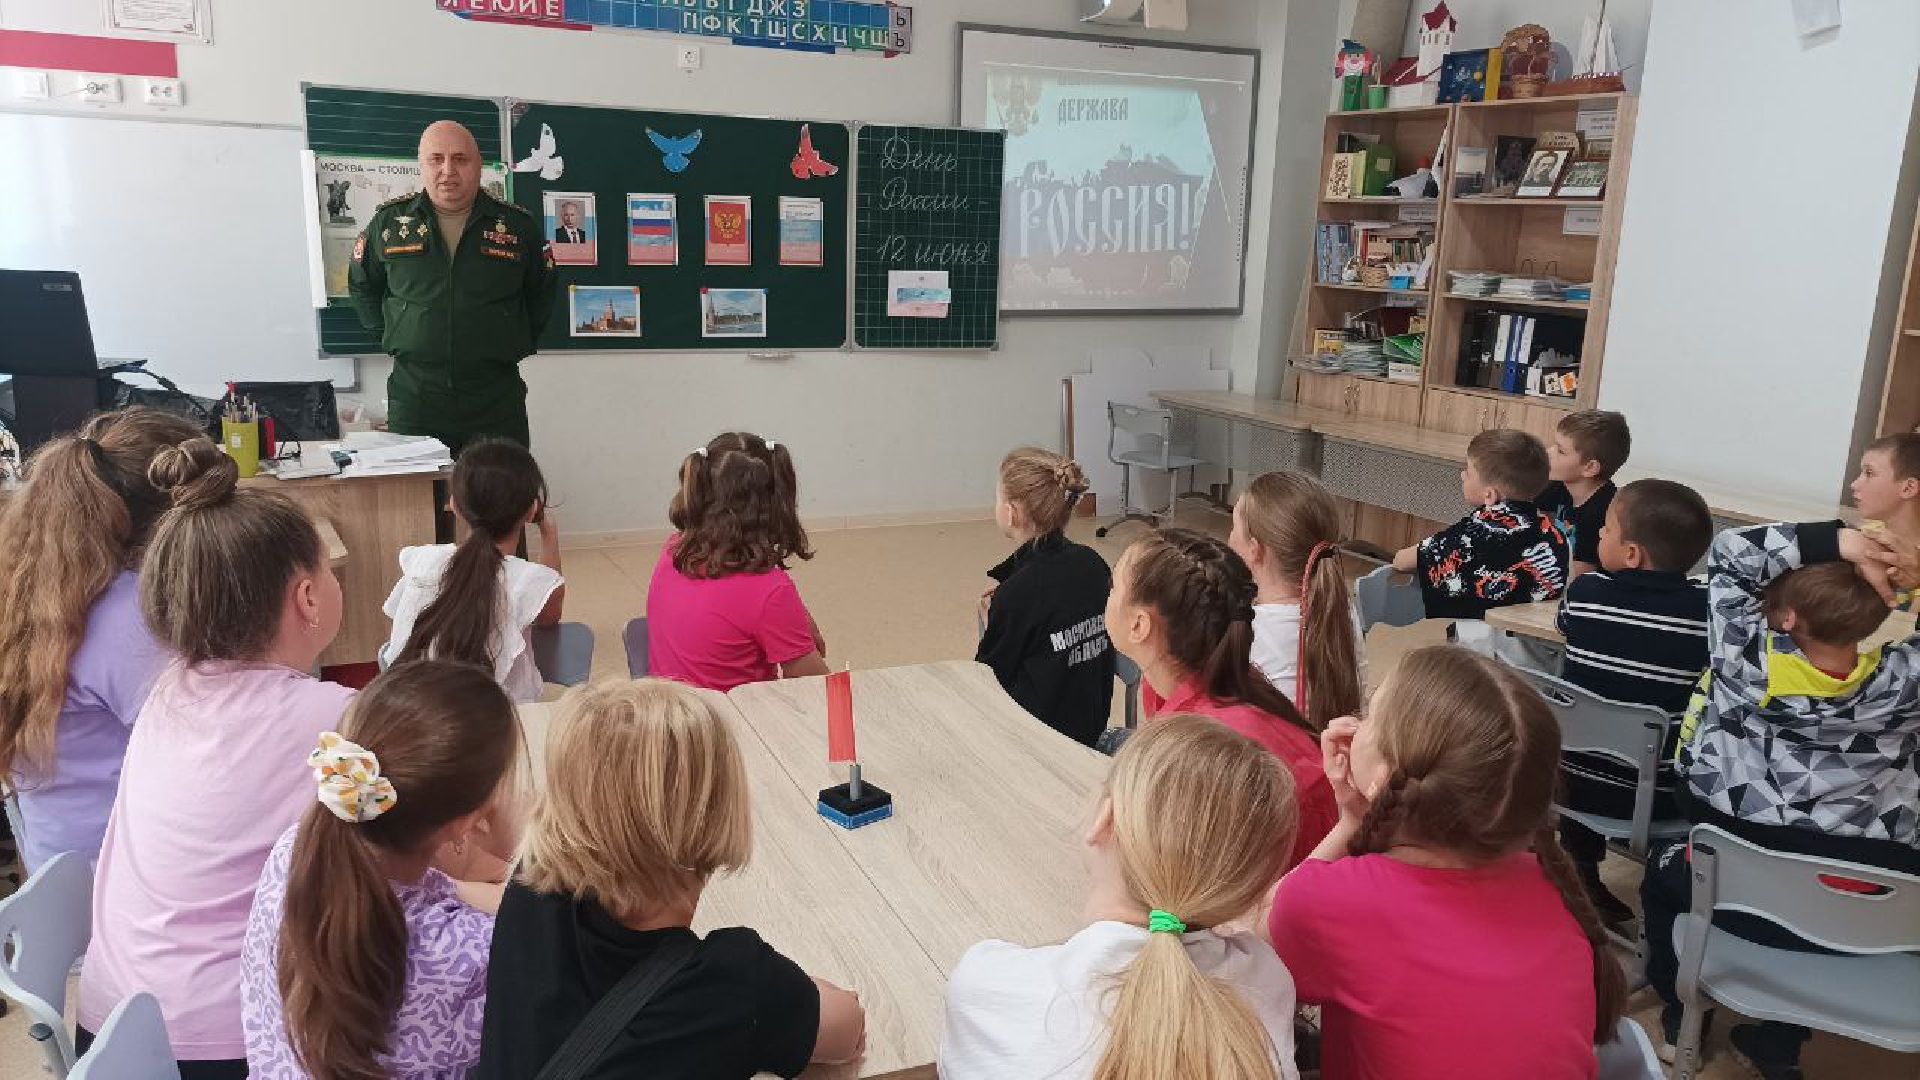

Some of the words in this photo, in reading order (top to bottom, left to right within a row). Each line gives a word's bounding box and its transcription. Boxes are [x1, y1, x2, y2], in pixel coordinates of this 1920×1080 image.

[1058, 97, 1129, 127] ДЕРЖАВА
[320, 161, 365, 174] МОСКВА
[378, 165, 421, 176] СТОЛИЦ
[881, 135, 959, 172] День
[879, 176, 971, 212] России
[876, 233, 907, 263] 12
[914, 240, 991, 265] июня
